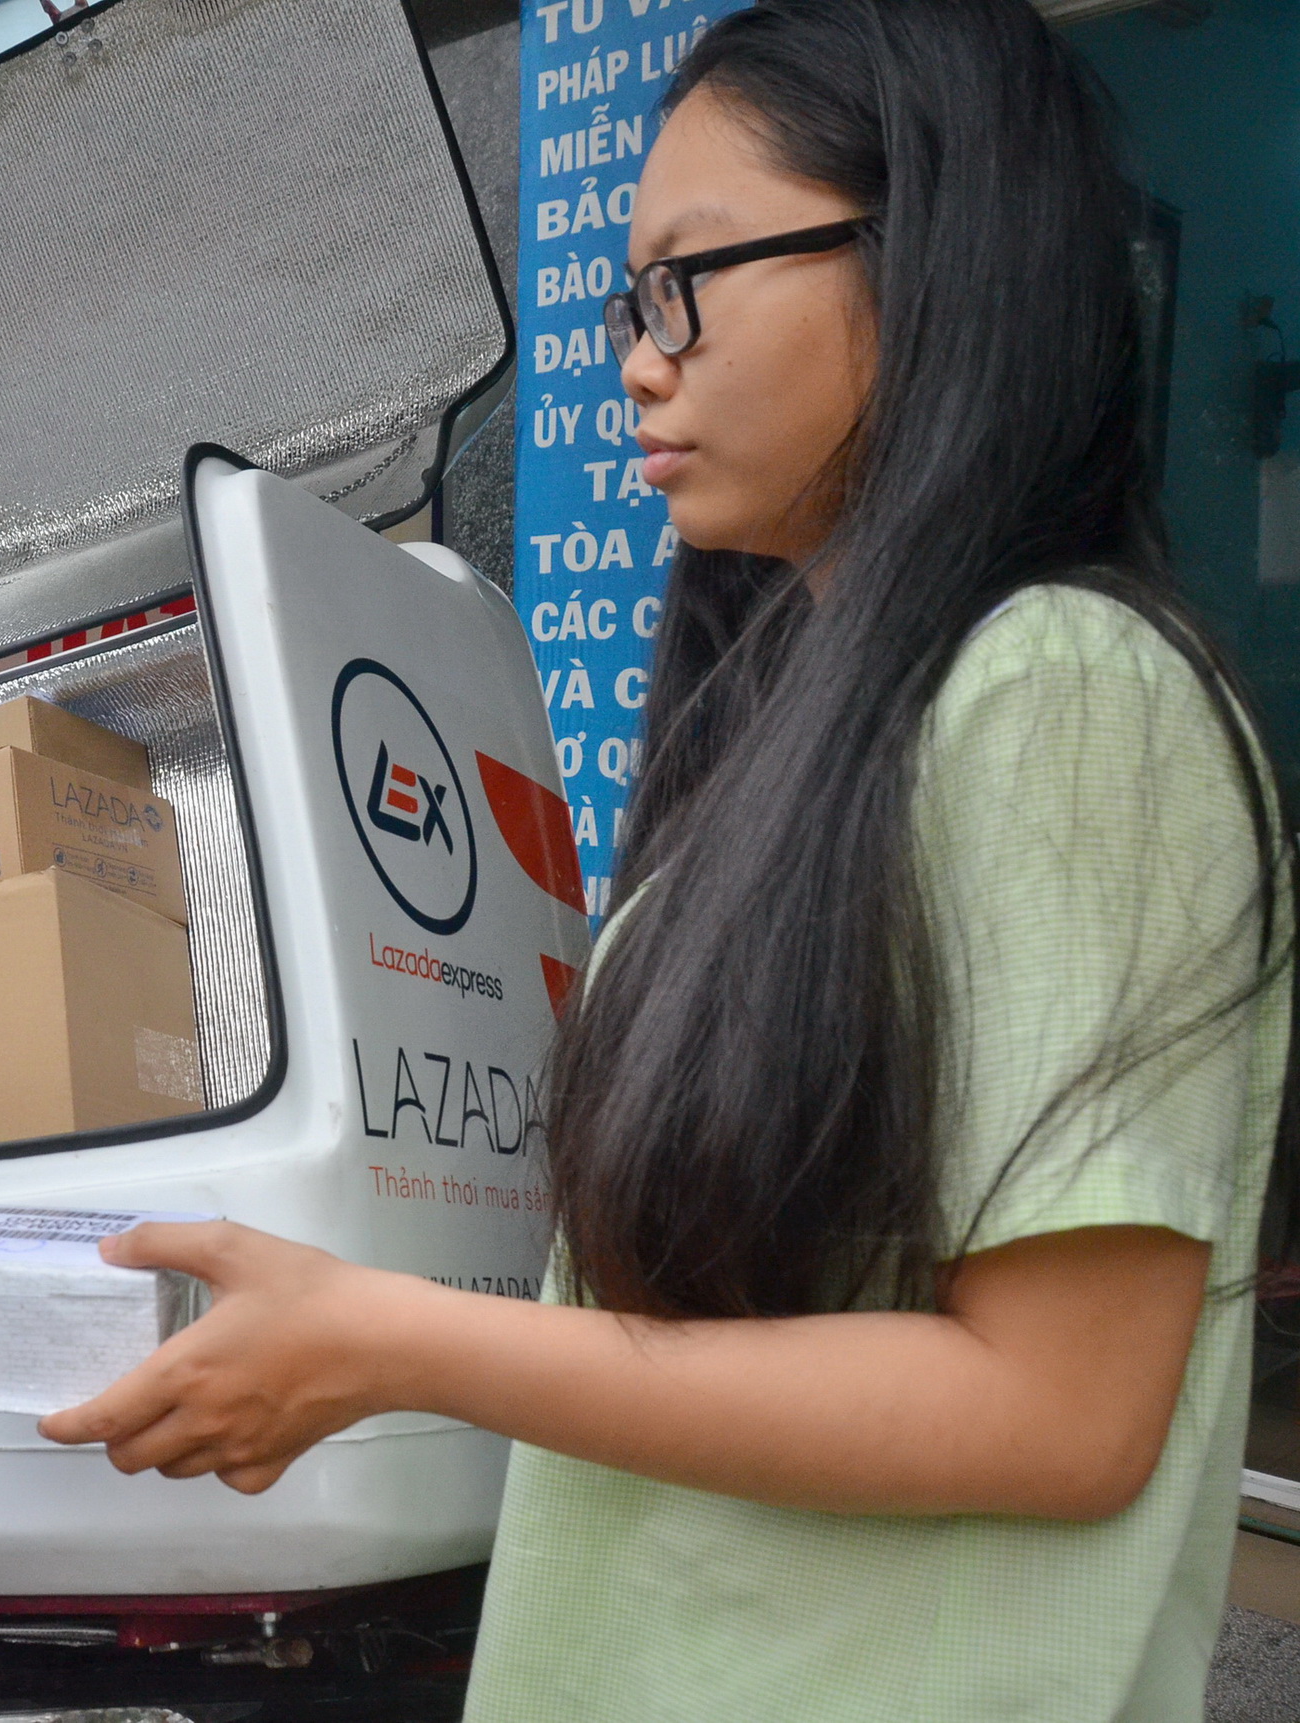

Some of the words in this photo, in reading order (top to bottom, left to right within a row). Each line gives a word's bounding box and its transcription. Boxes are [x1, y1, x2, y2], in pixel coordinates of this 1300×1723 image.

[538, 45, 630, 111] PHÁP
[540, 103, 643, 178] MIỄN
[536, 176, 638, 242] BẢO
[537, 252, 613, 307] BÀO
[533, 324, 606, 377] ĐẠI
[534, 393, 584, 449] ỦY
[584, 457, 666, 507] TẠ
[530, 521, 634, 575] TÒA
[531, 590, 617, 643] CÁC
[538, 659, 595, 710] VÀ
[555, 731, 587, 778] Ơ
[50, 776, 146, 833] LAZADA
[569, 795, 599, 847] À
[369, 931, 504, 1001] Lazadaexpress
[352, 1037, 552, 1158] LAZADA
[368, 1165, 436, 1201] Thảnh
[485, 1185, 520, 1212] mua
